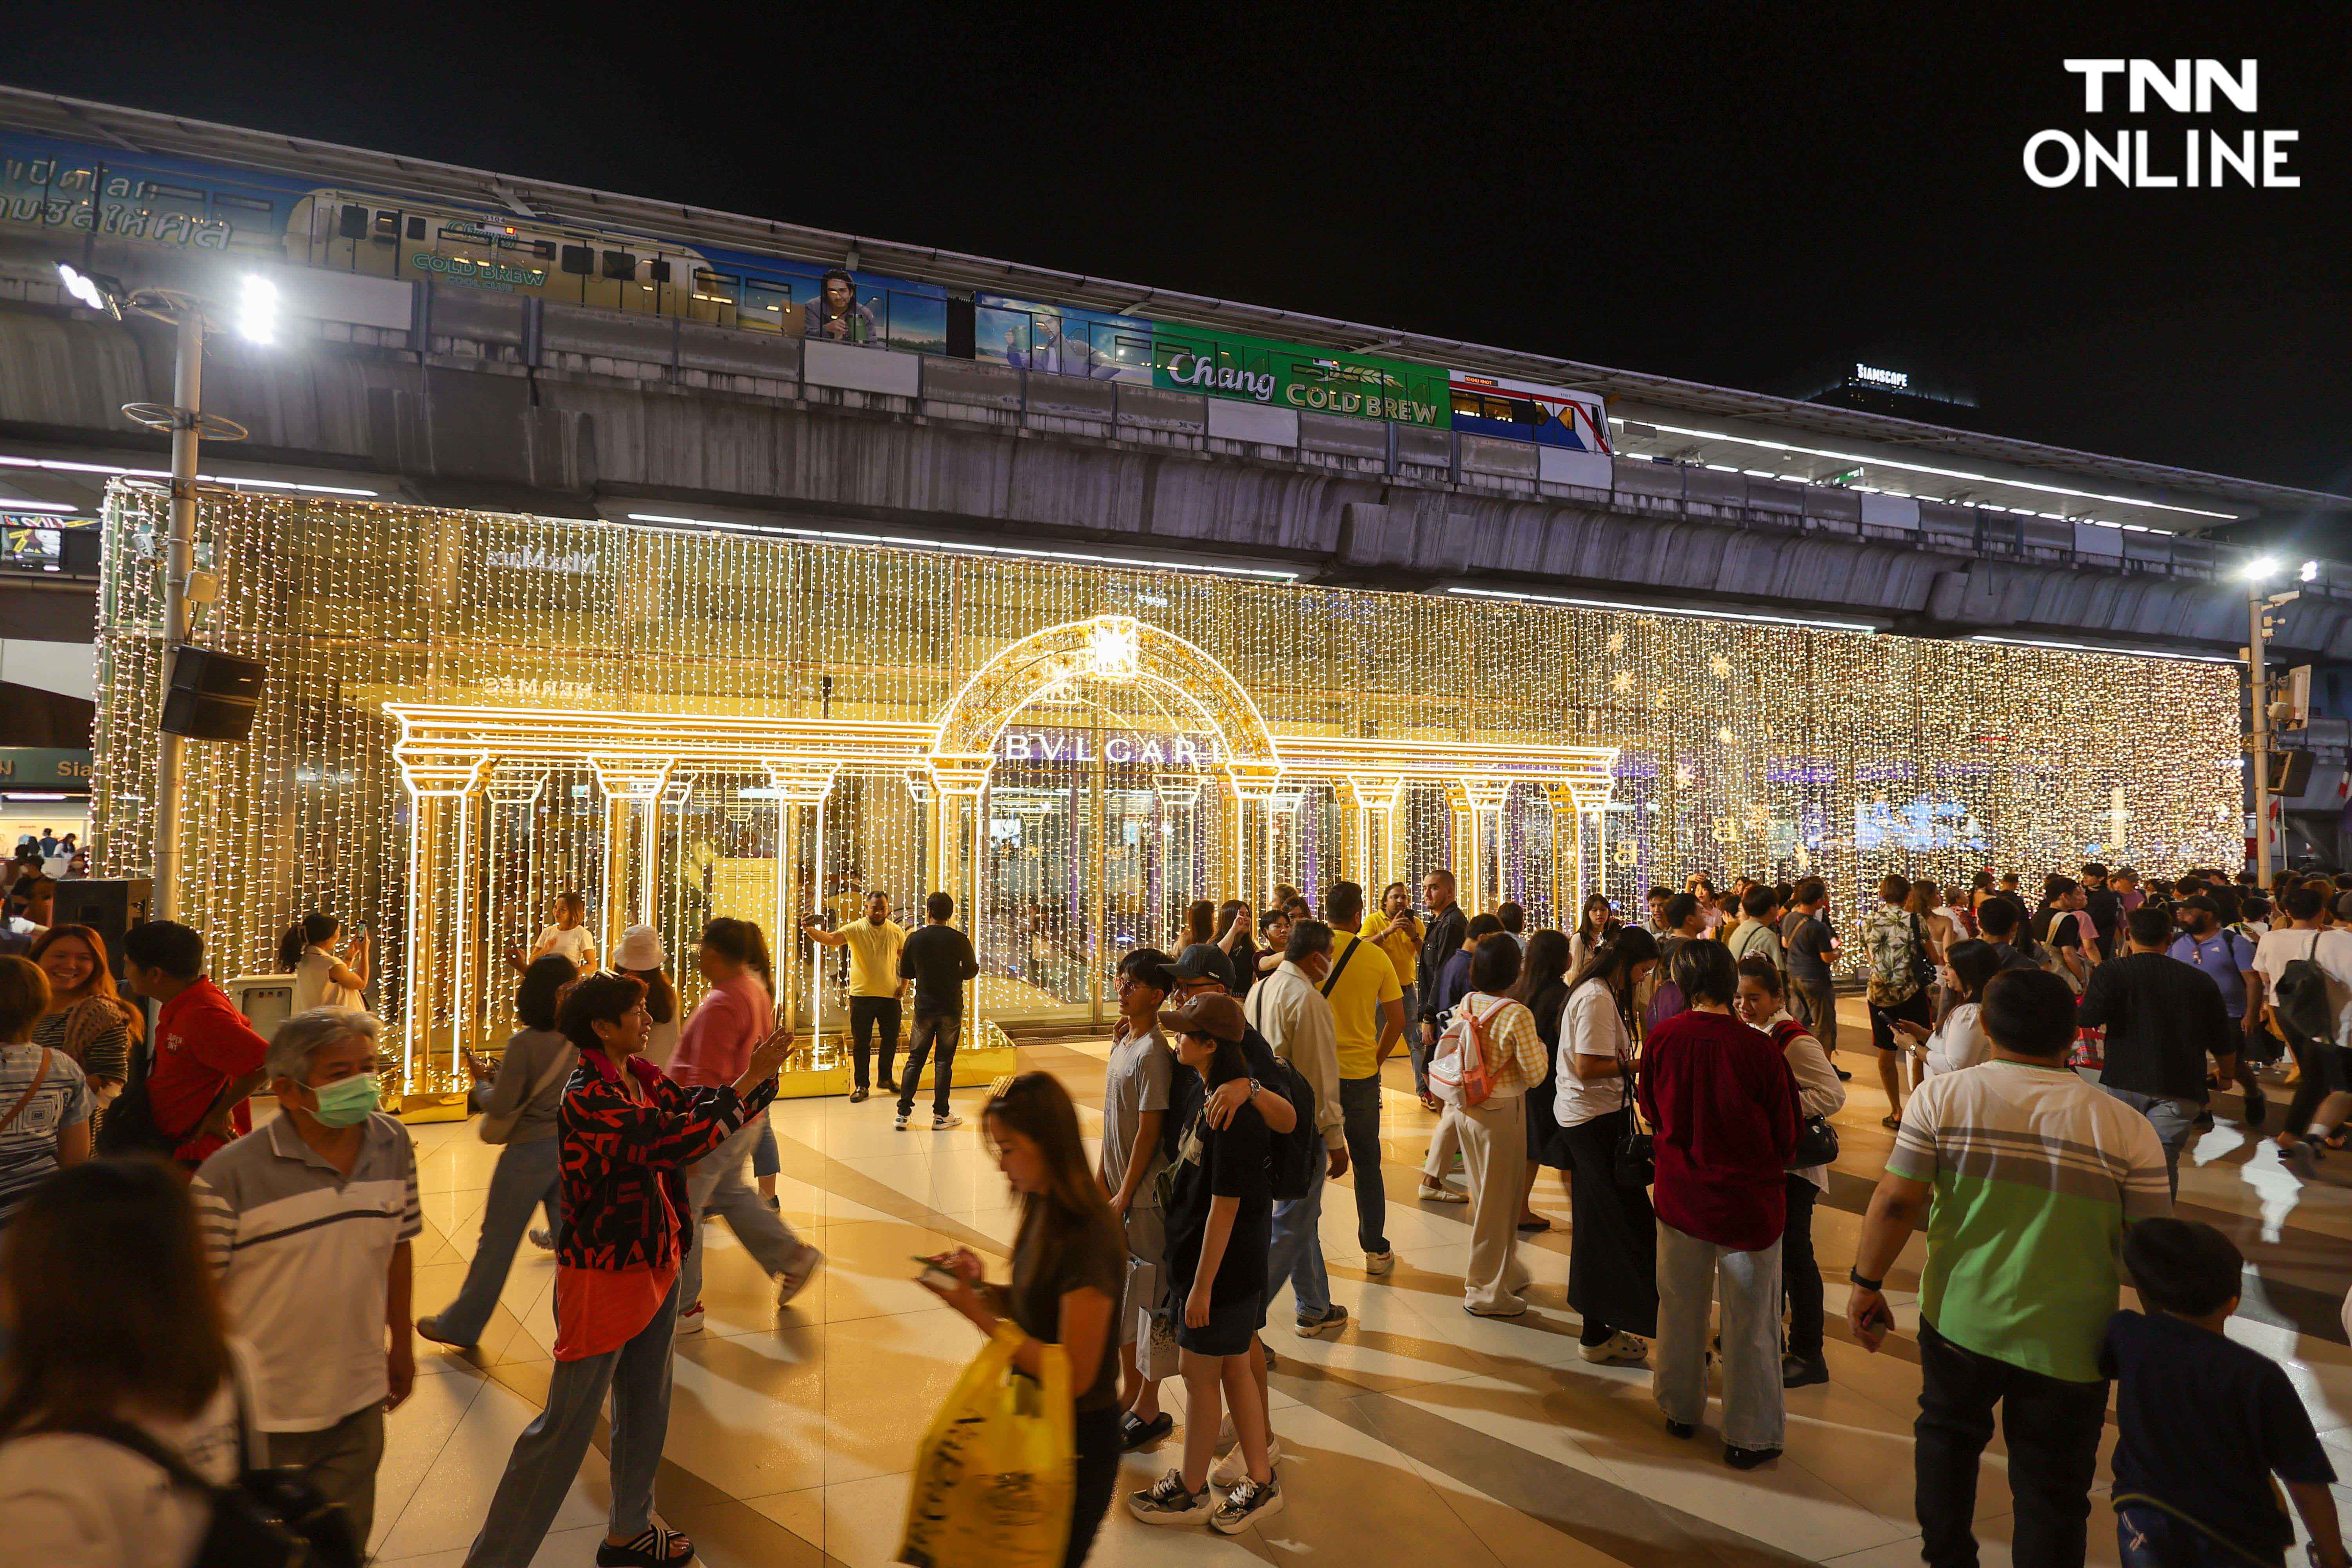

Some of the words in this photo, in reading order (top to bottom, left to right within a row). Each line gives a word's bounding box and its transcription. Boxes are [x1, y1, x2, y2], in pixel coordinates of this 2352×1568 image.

[412, 253, 476, 276] COLD
[481, 263, 546, 286] BREW
[1169, 352, 1276, 401] Chang
[1286, 383, 1361, 413] COLD
[1366, 395, 1437, 424] BREW
[1005, 735, 1223, 764] BVLGARI
[57, 761, 93, 777] Sia
[1125, 1417, 1138, 1431] PUMA
